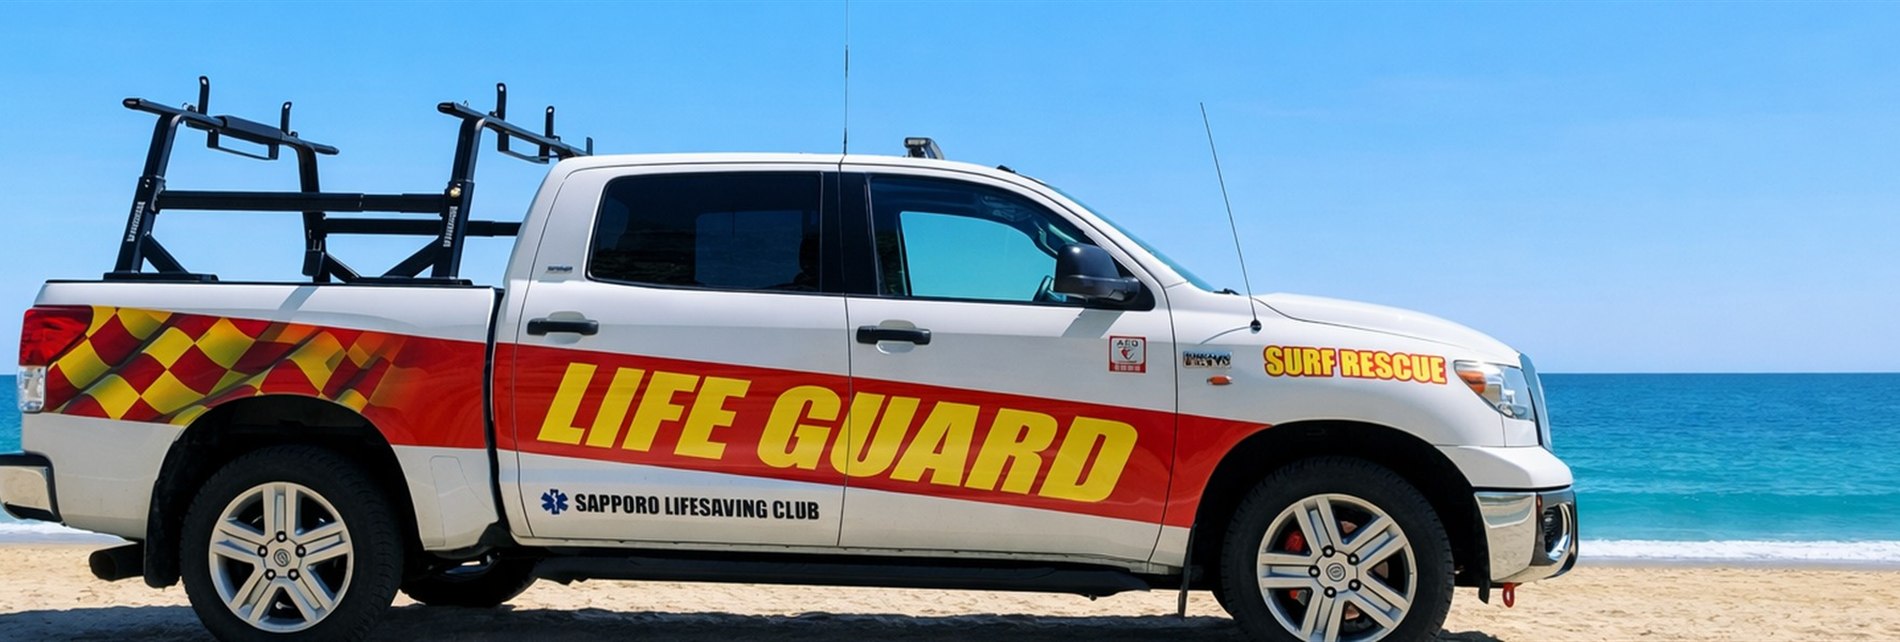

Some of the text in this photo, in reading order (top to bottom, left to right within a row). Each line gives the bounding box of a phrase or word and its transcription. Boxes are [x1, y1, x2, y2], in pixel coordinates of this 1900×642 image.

[1265, 347, 1335, 376] SURF
[1340, 350, 1446, 383] RESCUE
[537, 362, 1139, 503] LIFE GUARD
[574, 493, 820, 521] SAPPORO LIFESAVING CLUB
